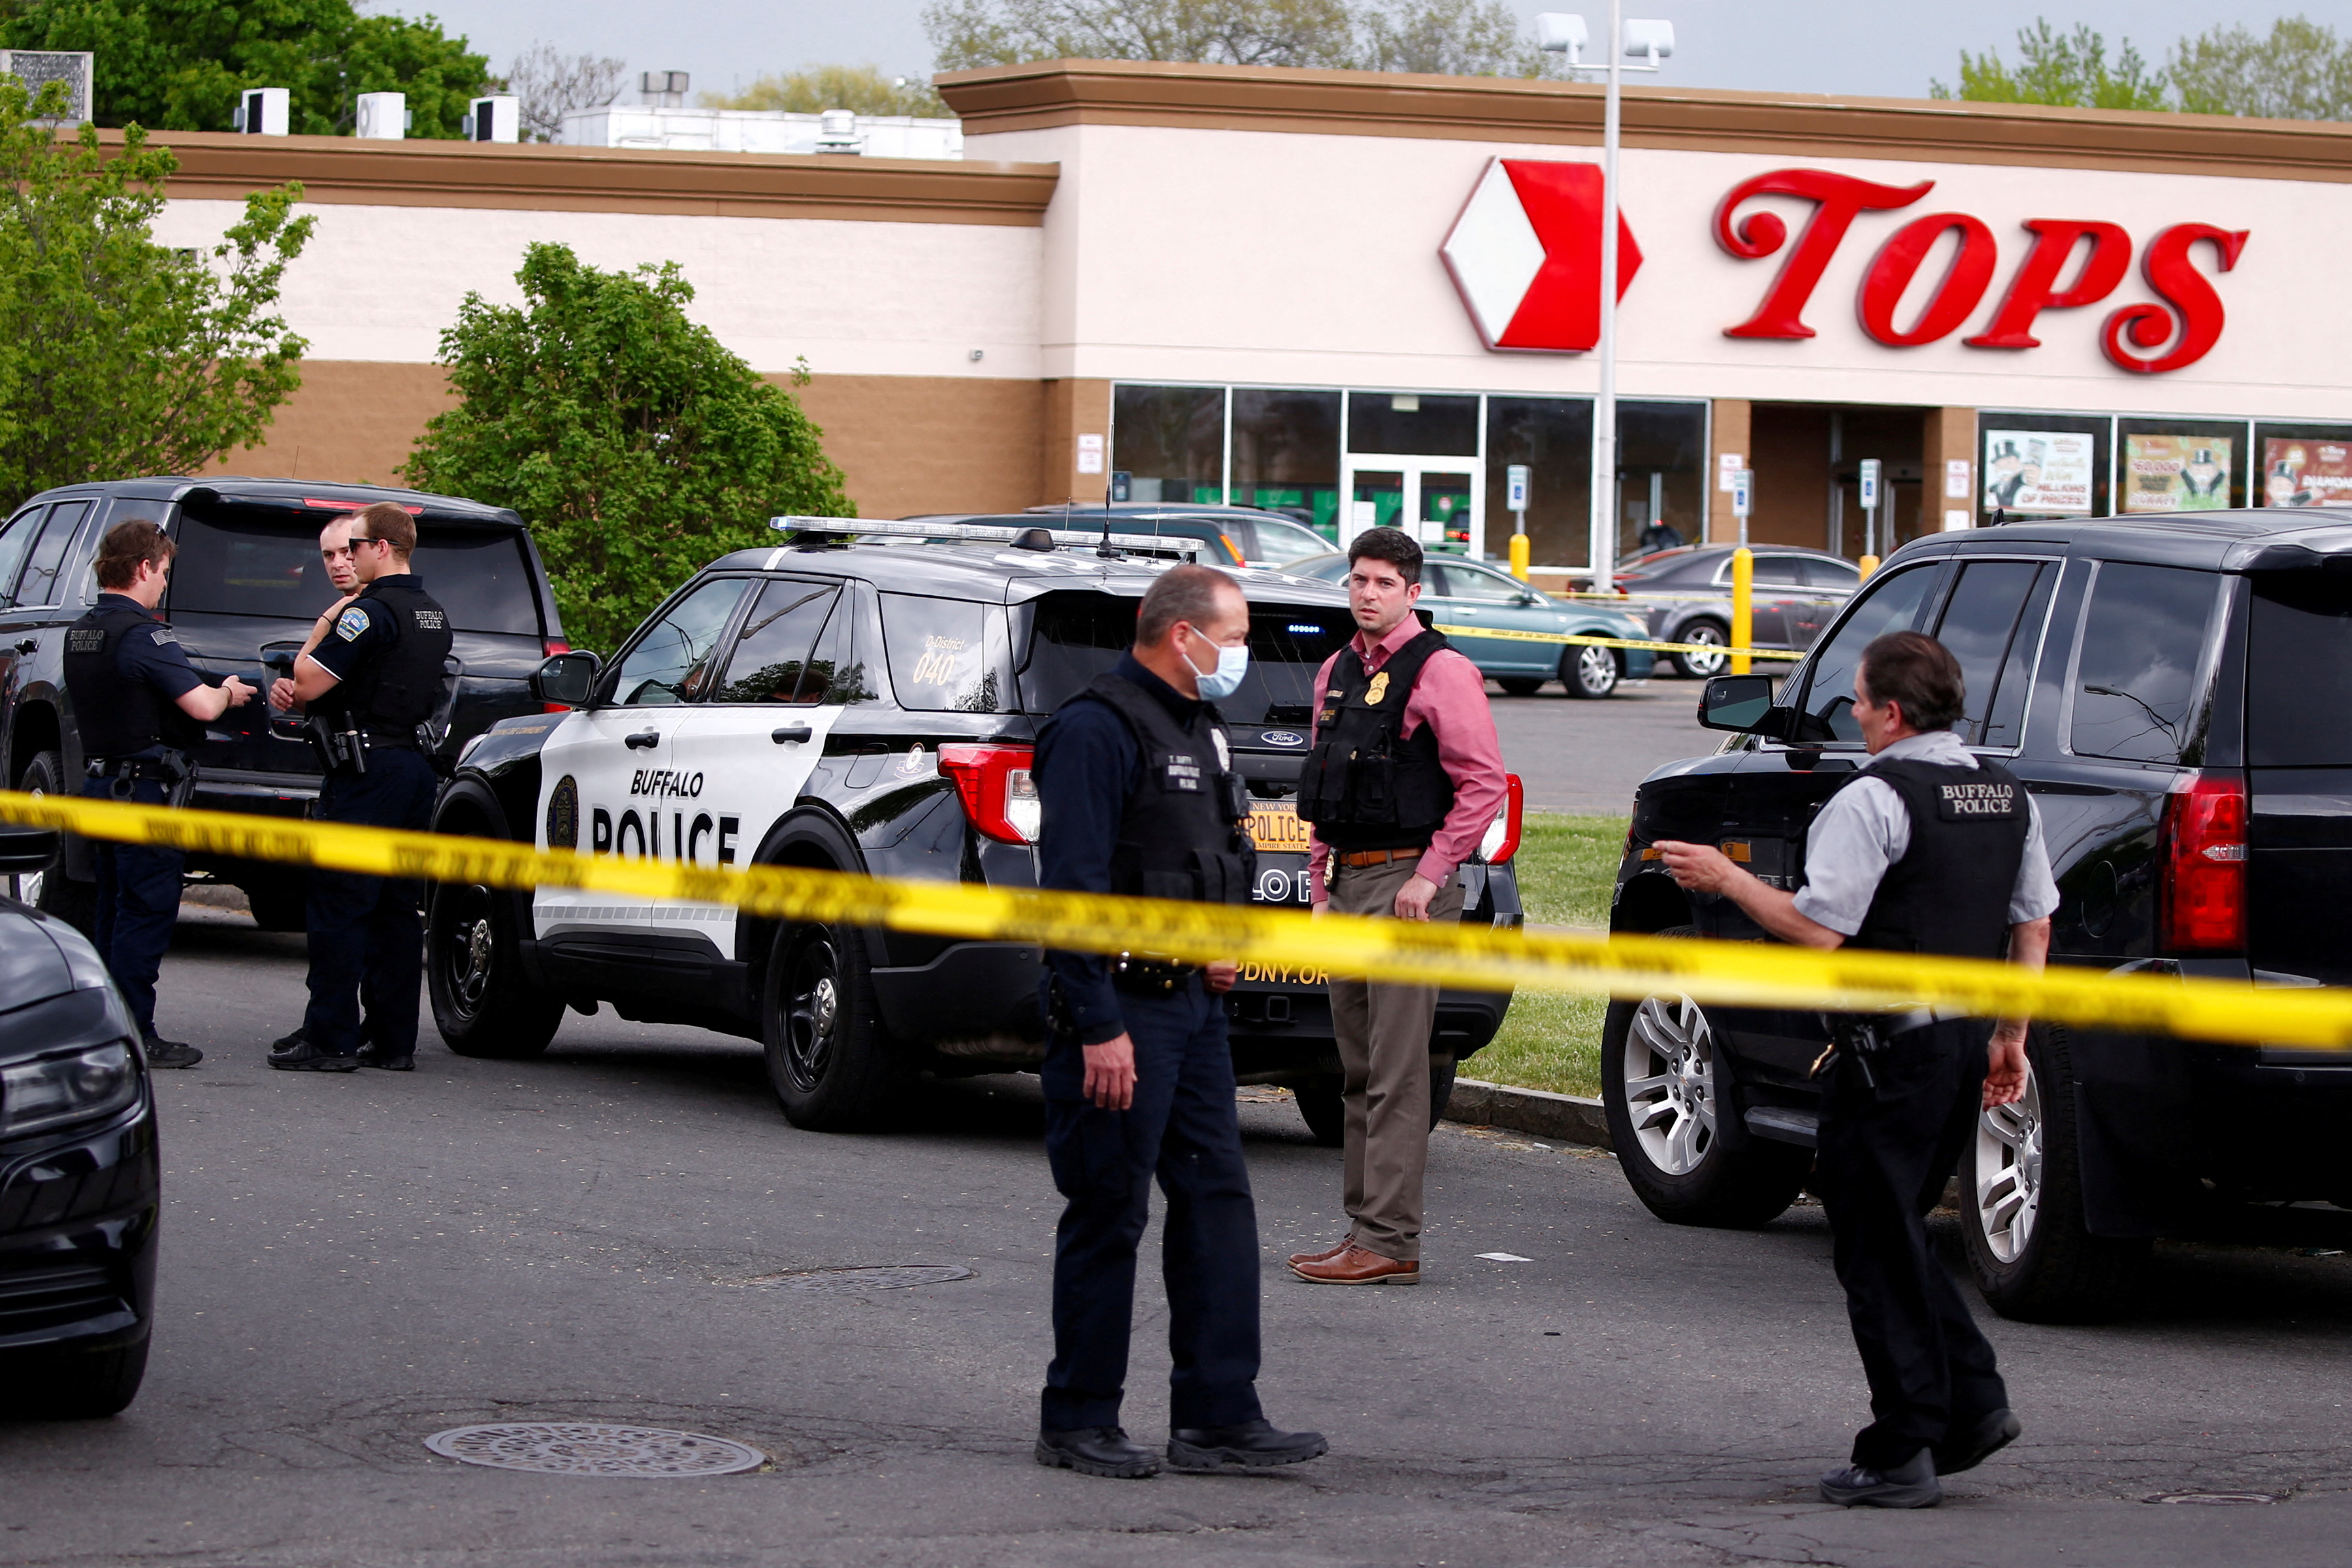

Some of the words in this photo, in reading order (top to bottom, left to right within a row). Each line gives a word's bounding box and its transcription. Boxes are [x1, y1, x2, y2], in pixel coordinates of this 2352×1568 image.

[1712, 167, 2251, 373] TOPS
[415, 611, 443, 621] BUFFALO
[419, 620, 442, 629] POLICE
[70, 629, 103, 640] BUFFALO
[71, 641, 98, 651] POLICE
[925, 635, 964, 650] D-District
[913, 651, 955, 686] 040
[1271, 732, 1294, 742] Ford
[630, 769, 704, 798] BUFFALO
[1941, 784, 2013, 798] BUFFALO
[1252, 802, 1275, 811] NEW
[1277, 803, 1297, 811] YOR
[1953, 799, 2012, 813] POLICE
[1249, 815, 1307, 842] POLICE
[593, 808, 740, 867] POLICE
